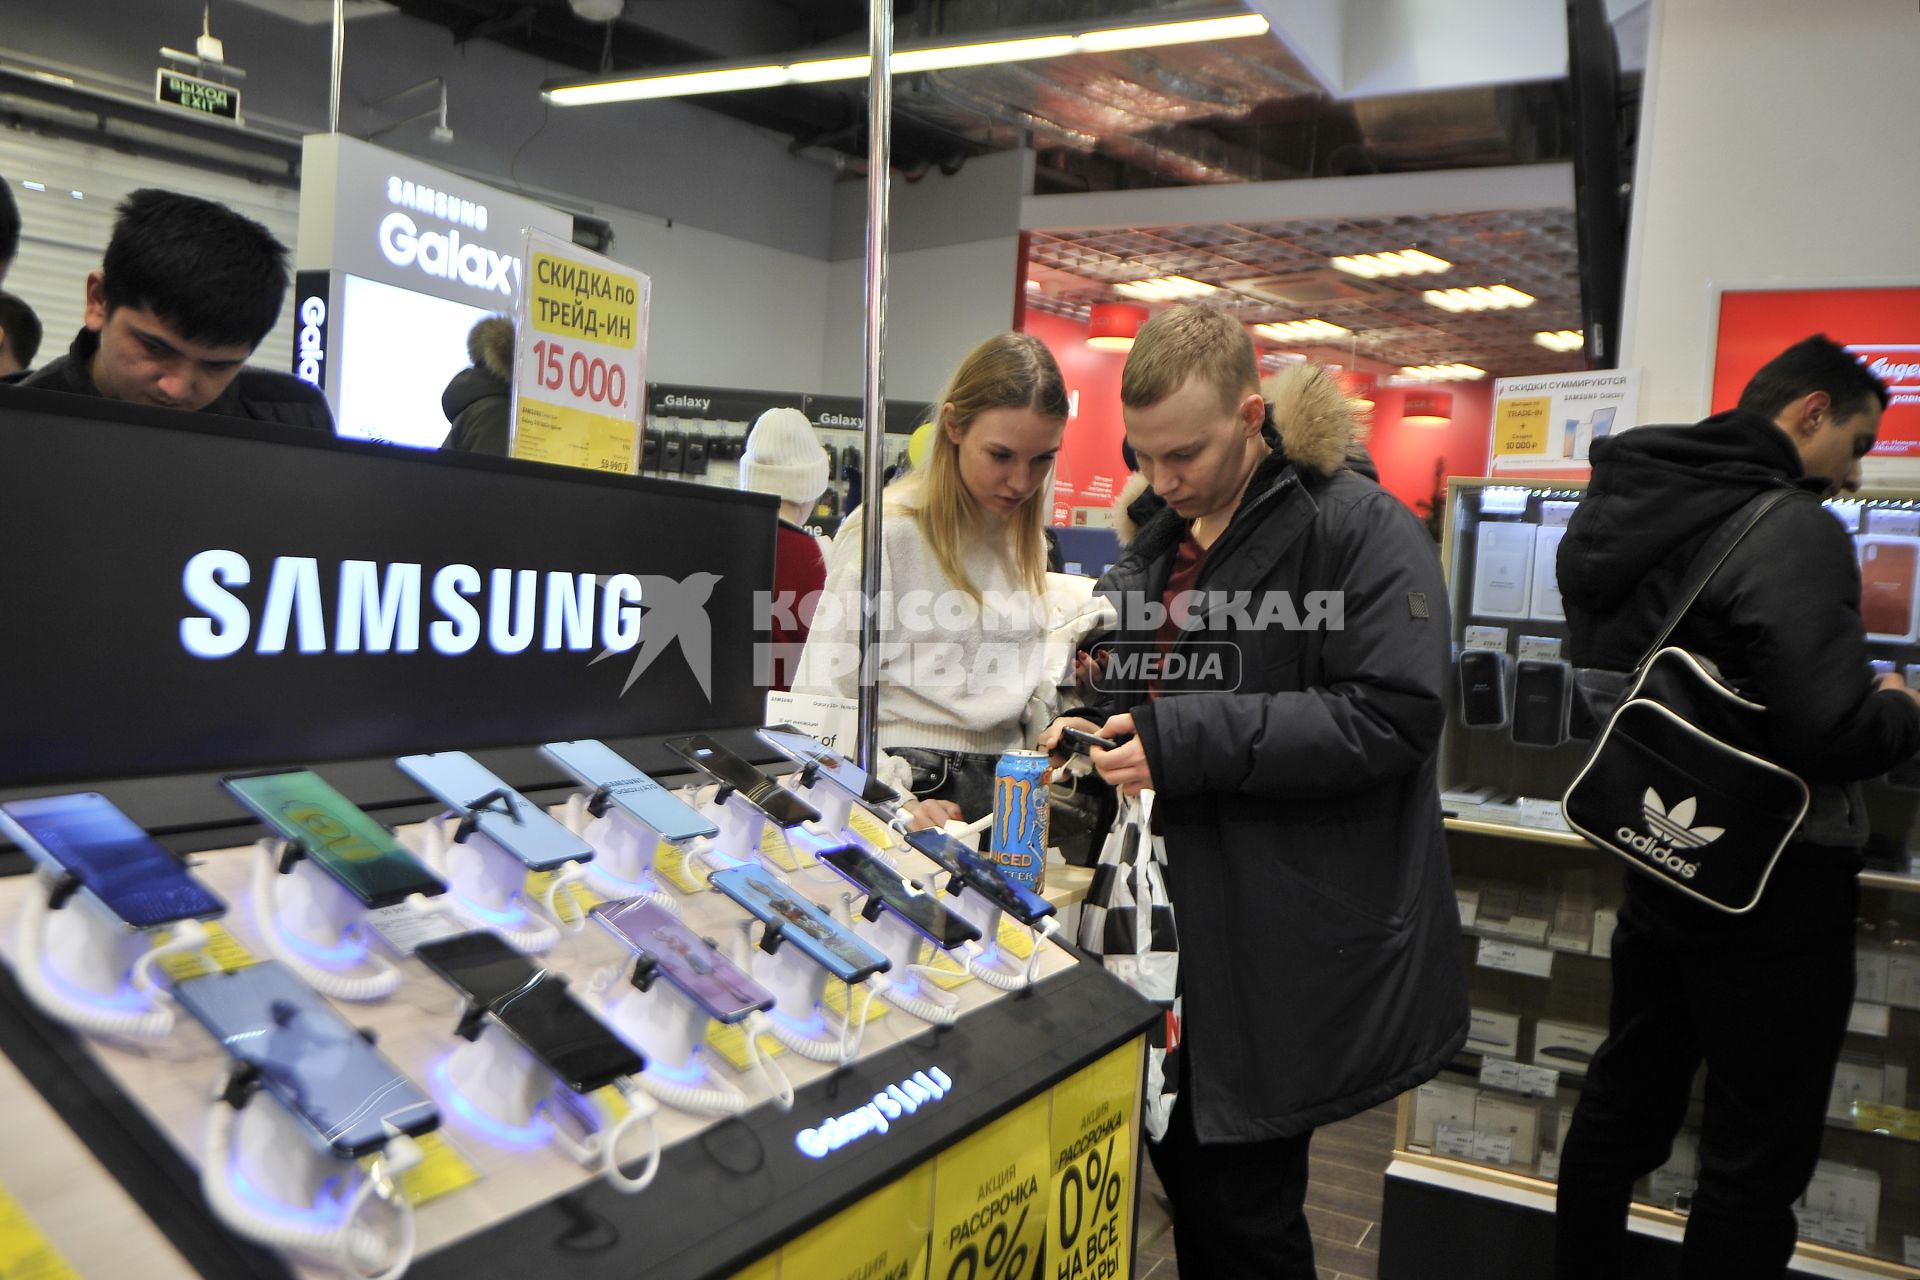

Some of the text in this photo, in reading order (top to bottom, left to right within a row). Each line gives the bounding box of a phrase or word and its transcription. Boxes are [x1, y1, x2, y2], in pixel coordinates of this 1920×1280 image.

[170, 78, 228, 109] ВЫХОД
[181, 92, 214, 112] EXIT
[387, 176, 488, 231] SAMSUNG
[537, 258, 612, 300] СКИДКА
[538, 296, 631, 340] ТРЕЙД-ИН
[299, 296, 326, 385] Gala
[533, 339, 564, 390] 15
[1509, 376, 1627, 393] СКИДКИ СУММИРУЮТСЯ
[1564, 393, 1598, 401] SAMSUNG
[180, 549, 643, 659] SAMSUNG
[1617, 827, 1697, 878] adidas
[1081, 1101, 1109, 1128] АКЦИЯ
[977, 1164, 1016, 1202] АКЦИЯ
[1058, 1212, 1119, 1280] НА ВСЕ
